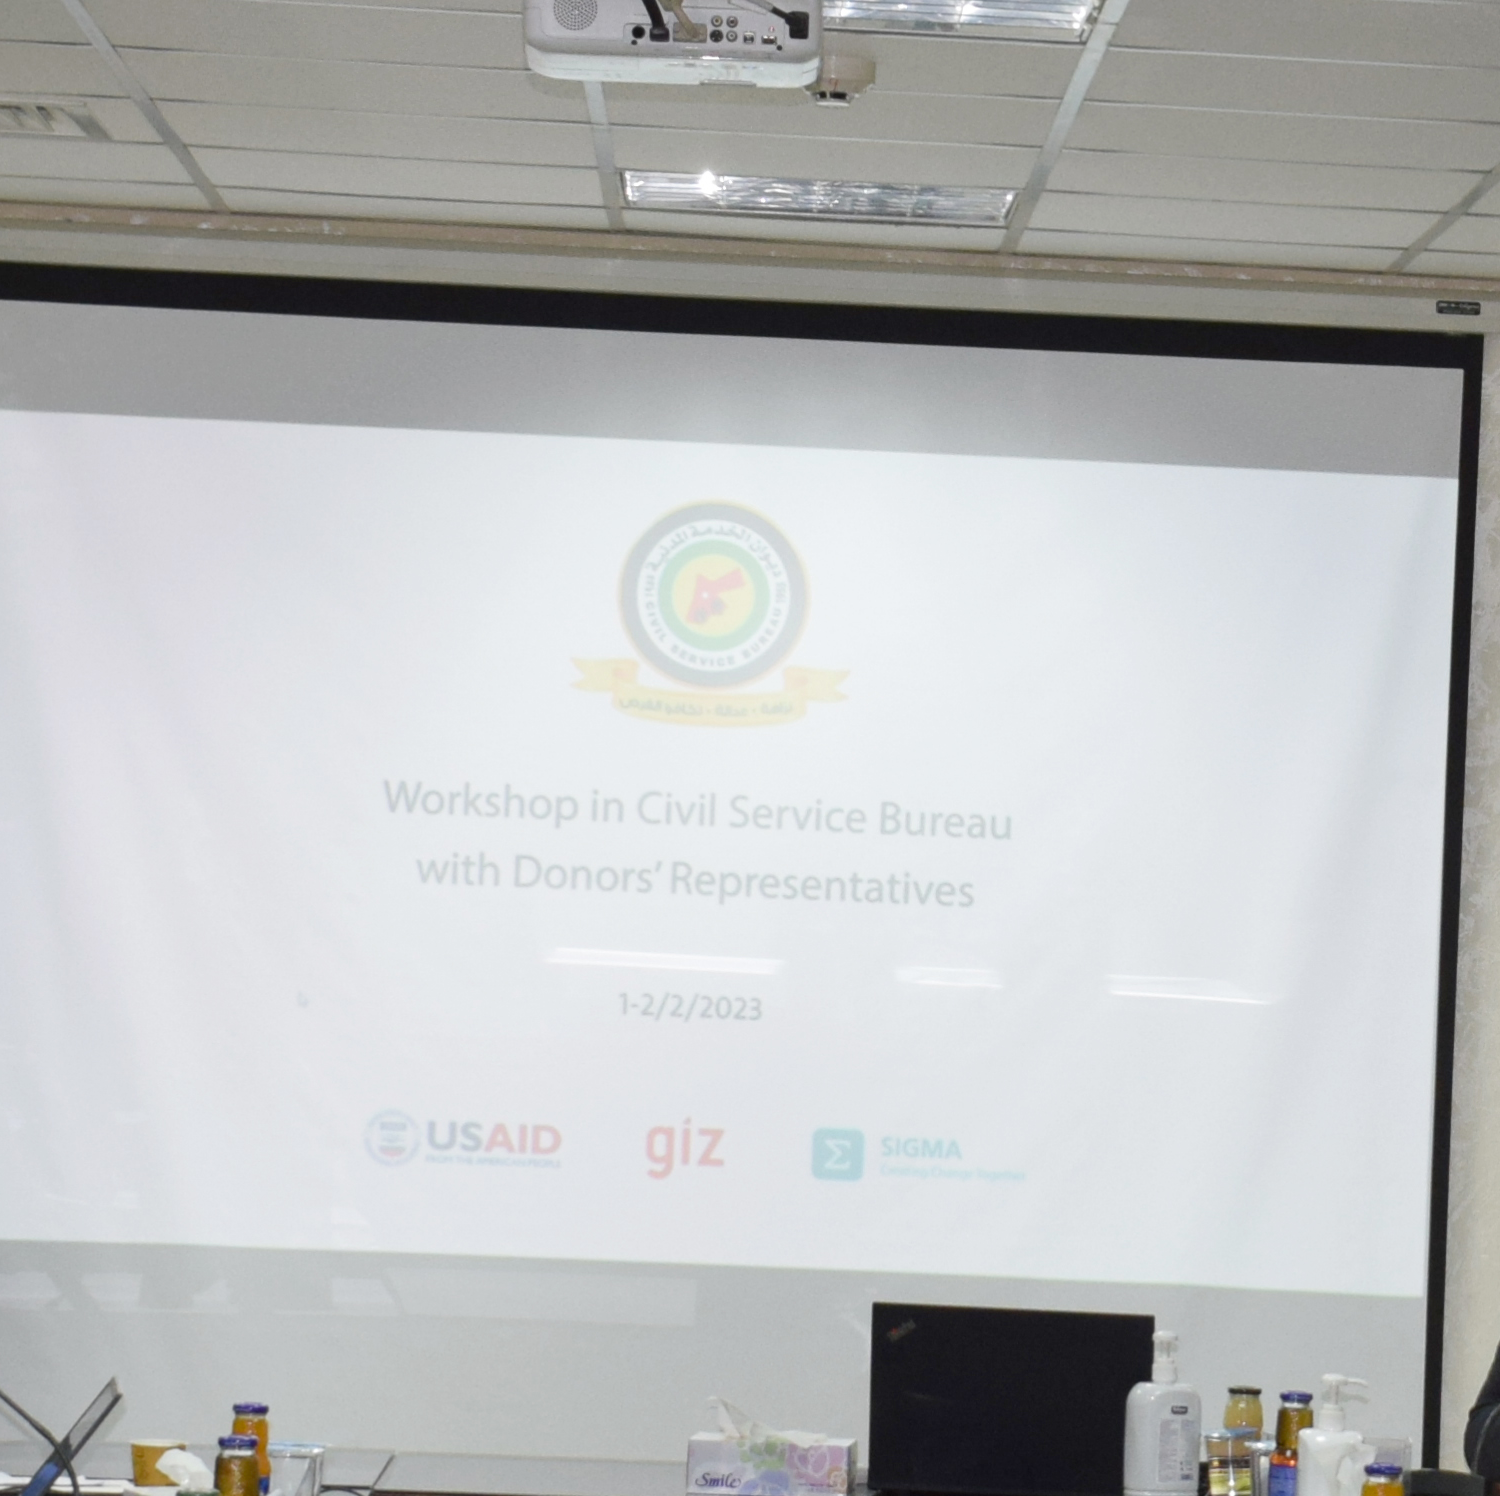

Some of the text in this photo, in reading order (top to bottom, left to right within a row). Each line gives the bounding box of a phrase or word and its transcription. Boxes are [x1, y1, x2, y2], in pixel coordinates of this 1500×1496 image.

[645, 603, 783, 668] CIVIL SERVICE BUREAU
[383, 778, 1014, 840] Workshop in Civil Service Bureau
[415, 852, 975, 907] with Donors’ Representatives
[618, 991, 763, 1023] 1-2/2/2023
[426, 1119, 563, 1155] USAID
[646, 1115, 726, 1180] giz
[880, 1135, 963, 1160] SIGMA
[695, 1471, 742, 1489] Smile
